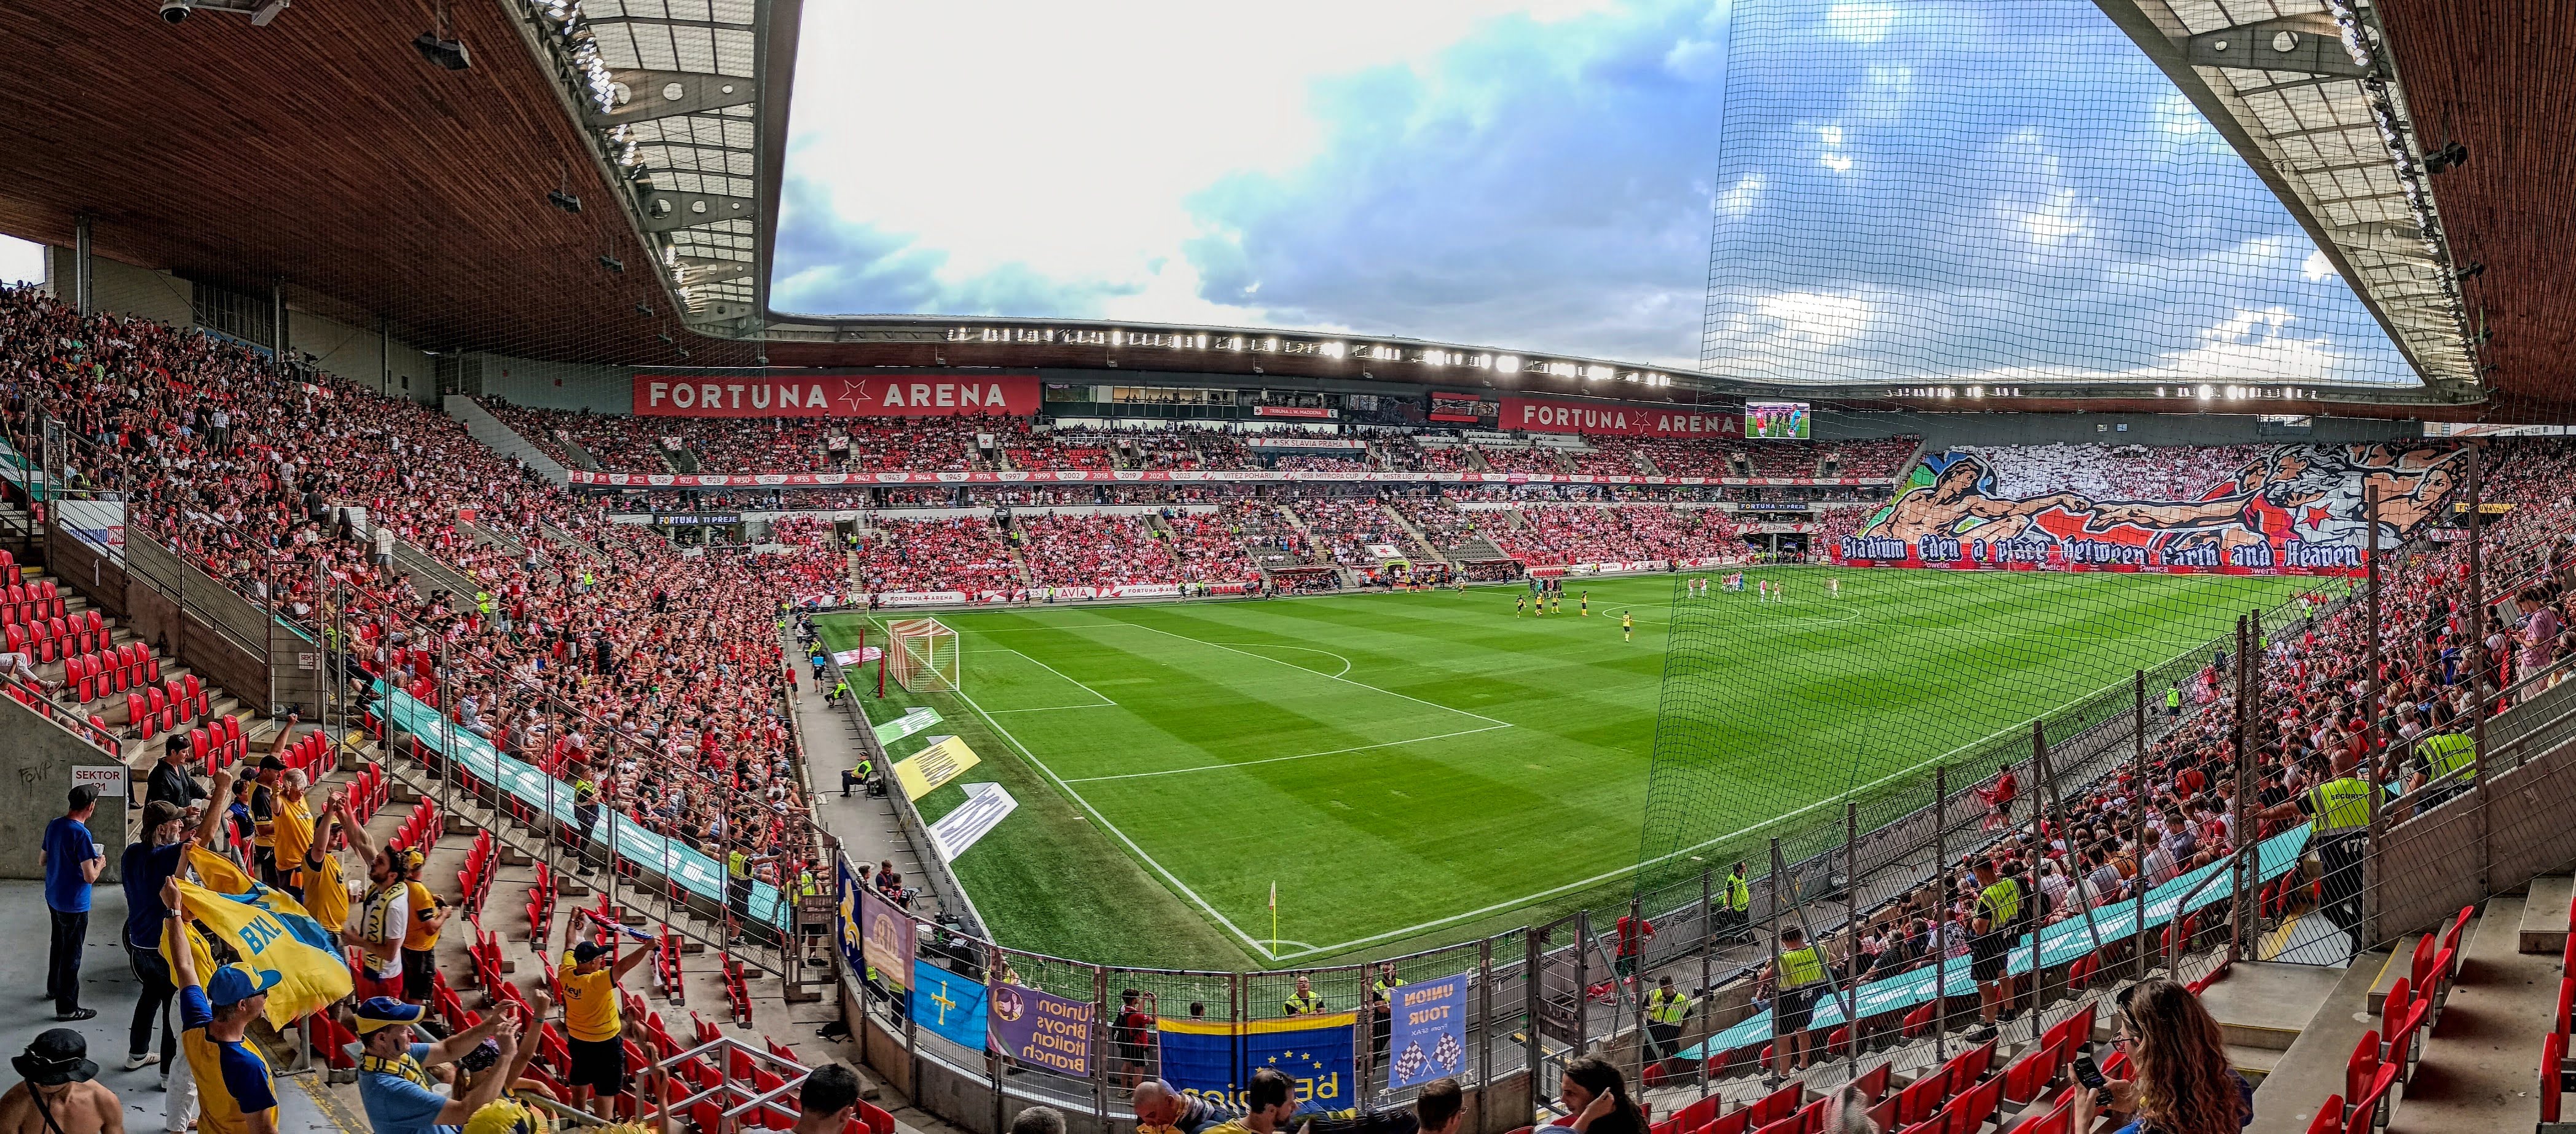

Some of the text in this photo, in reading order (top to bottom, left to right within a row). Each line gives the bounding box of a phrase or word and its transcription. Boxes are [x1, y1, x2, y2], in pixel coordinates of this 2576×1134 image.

[650, 382, 1006, 409] FORTUNA ARENA
[1524, 405, 1735, 433] FORTUNA ARENA
[659, 516, 699, 525] FORTUNA
[1842, 535, 2358, 566] Stadium Eden a place between Earth and Heaven
[1053, 588, 1088, 599] LAVIA
[76, 770, 120, 780] SEKTOR
[937, 789, 1007, 857] VISA
[239, 914, 283, 956] BXL
